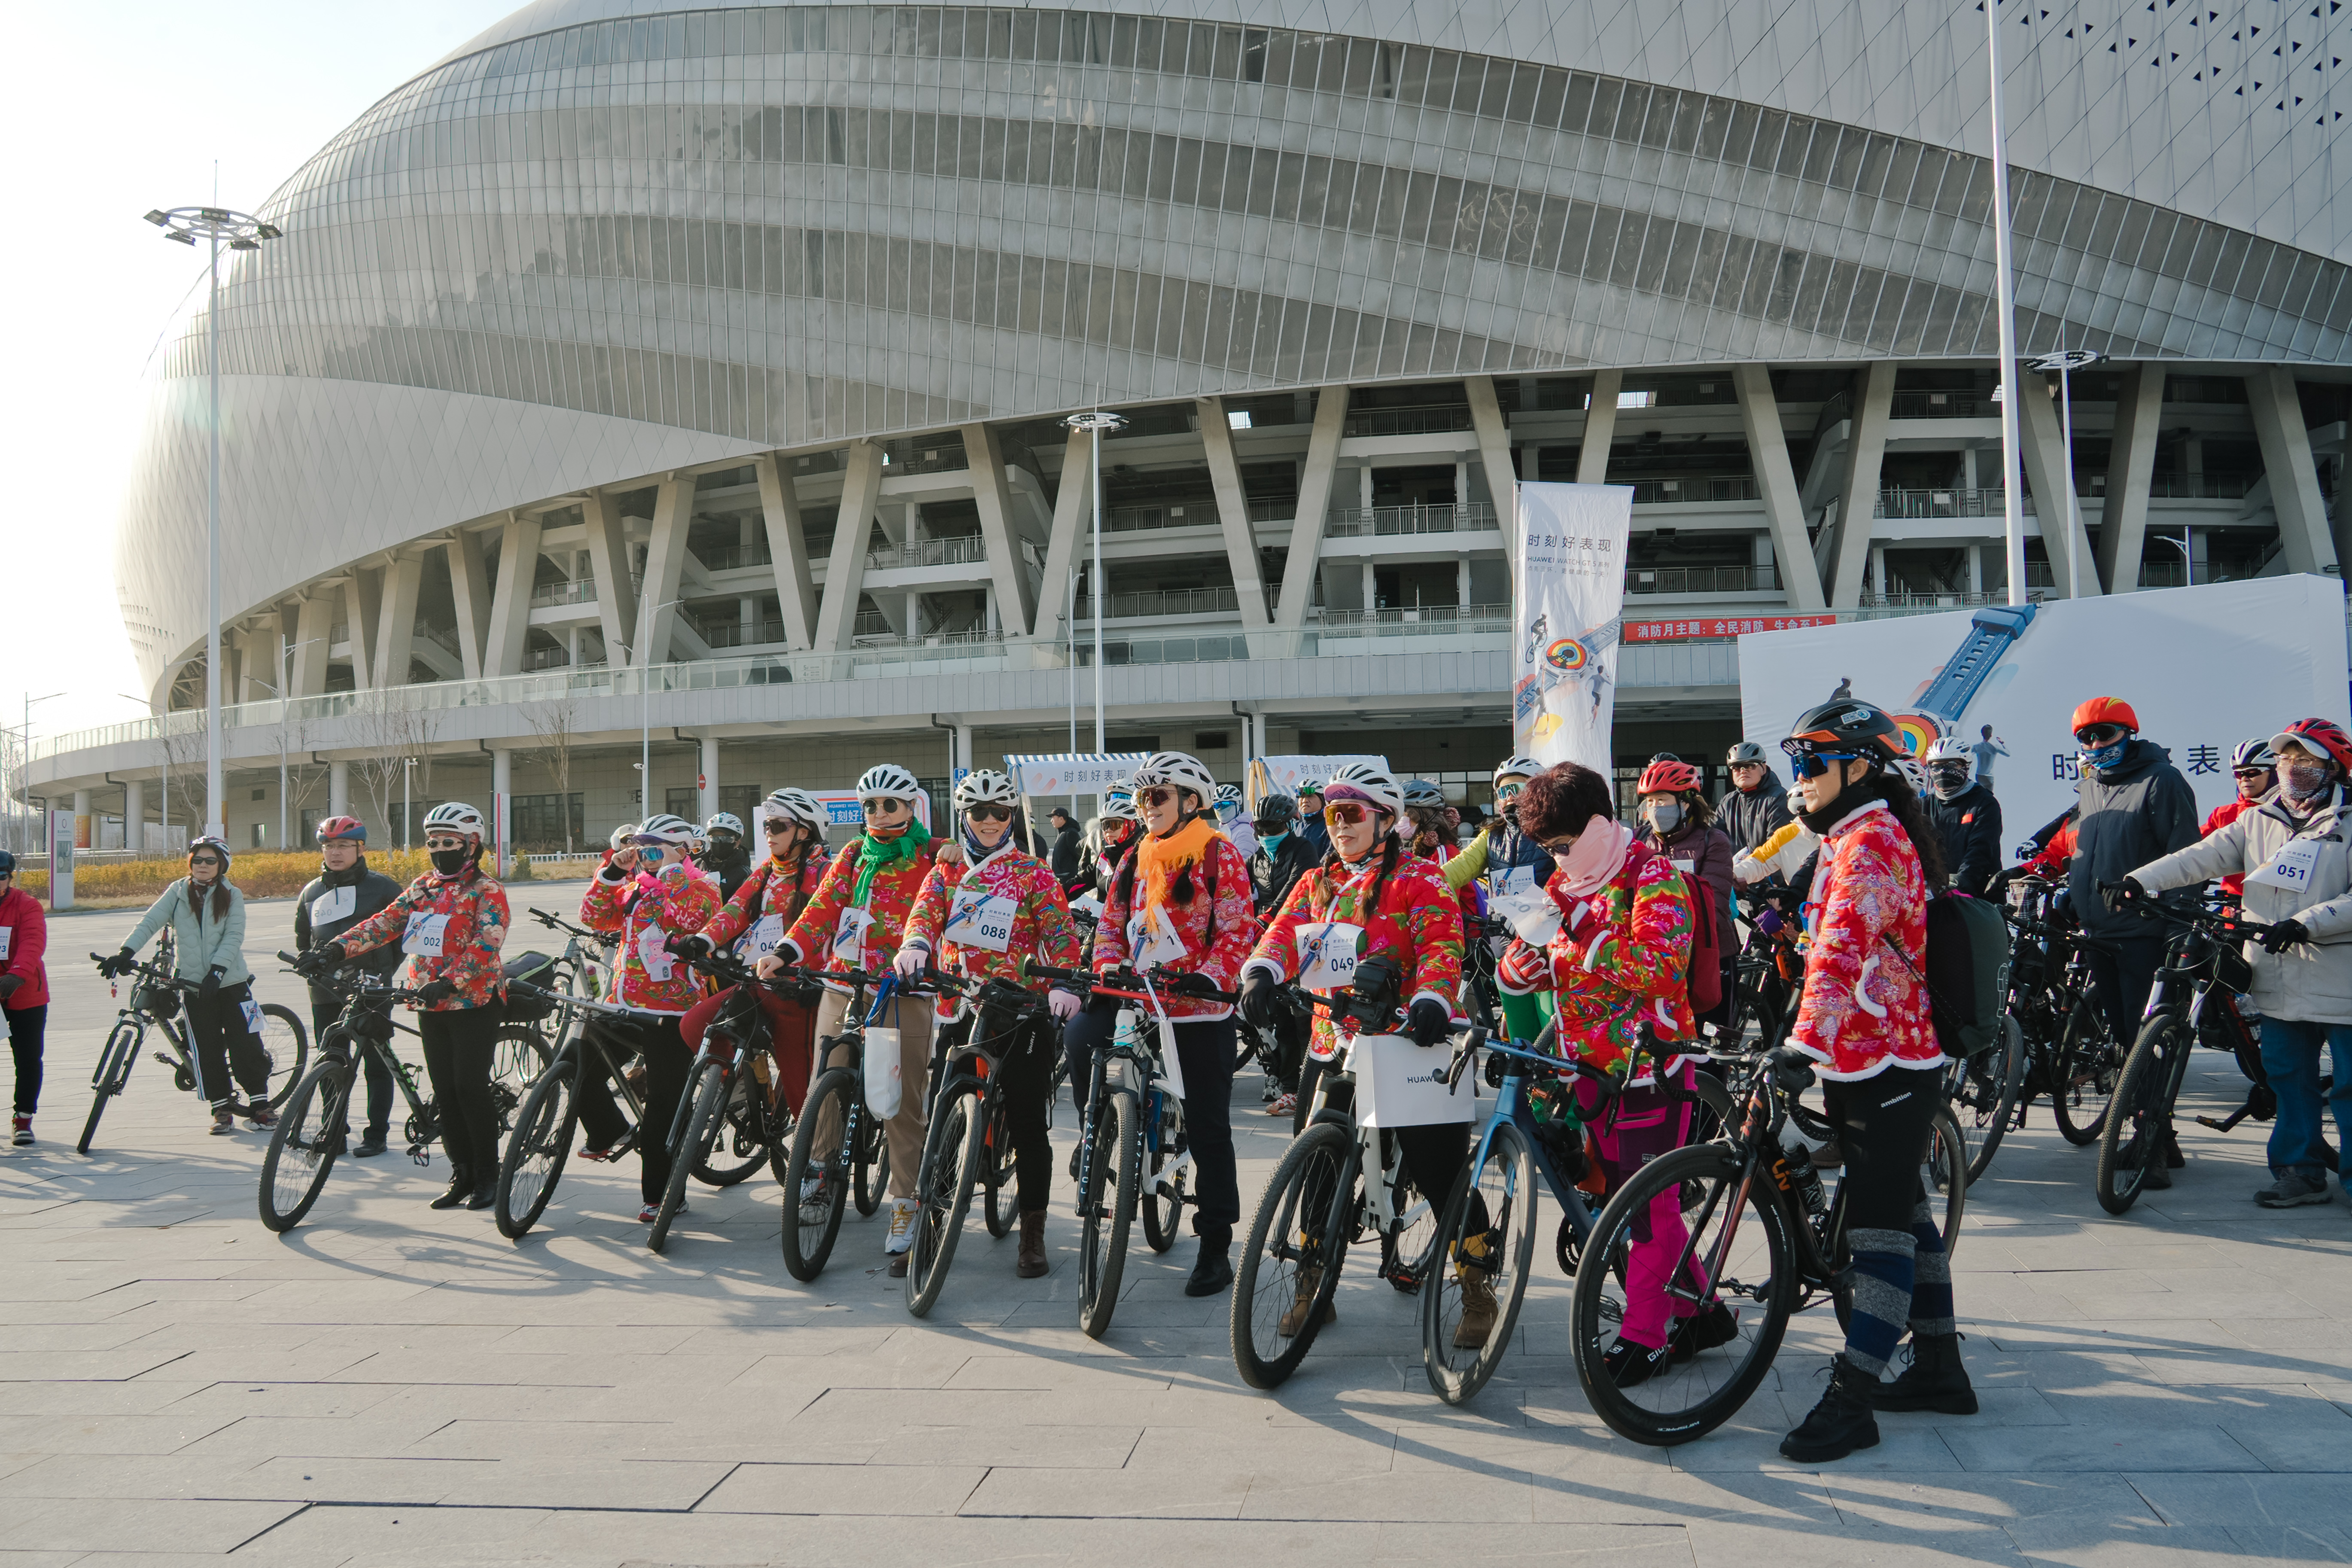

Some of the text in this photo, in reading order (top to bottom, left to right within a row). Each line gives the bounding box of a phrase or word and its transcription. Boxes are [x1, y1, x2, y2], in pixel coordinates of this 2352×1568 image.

[1528, 534, 1610, 552] 时刻好表现
[1064, 770, 1126, 782] 时刻好表现
[2278, 865, 2305, 880] 051
[981, 925, 1006, 939] 088
[424, 937, 440, 947] 002
[761, 940, 779, 952] 04
[1331, 957, 1354, 971] 049
[1880, 1092, 1912, 1108] ambition
[842, 1103, 859, 1165] MANITOU
